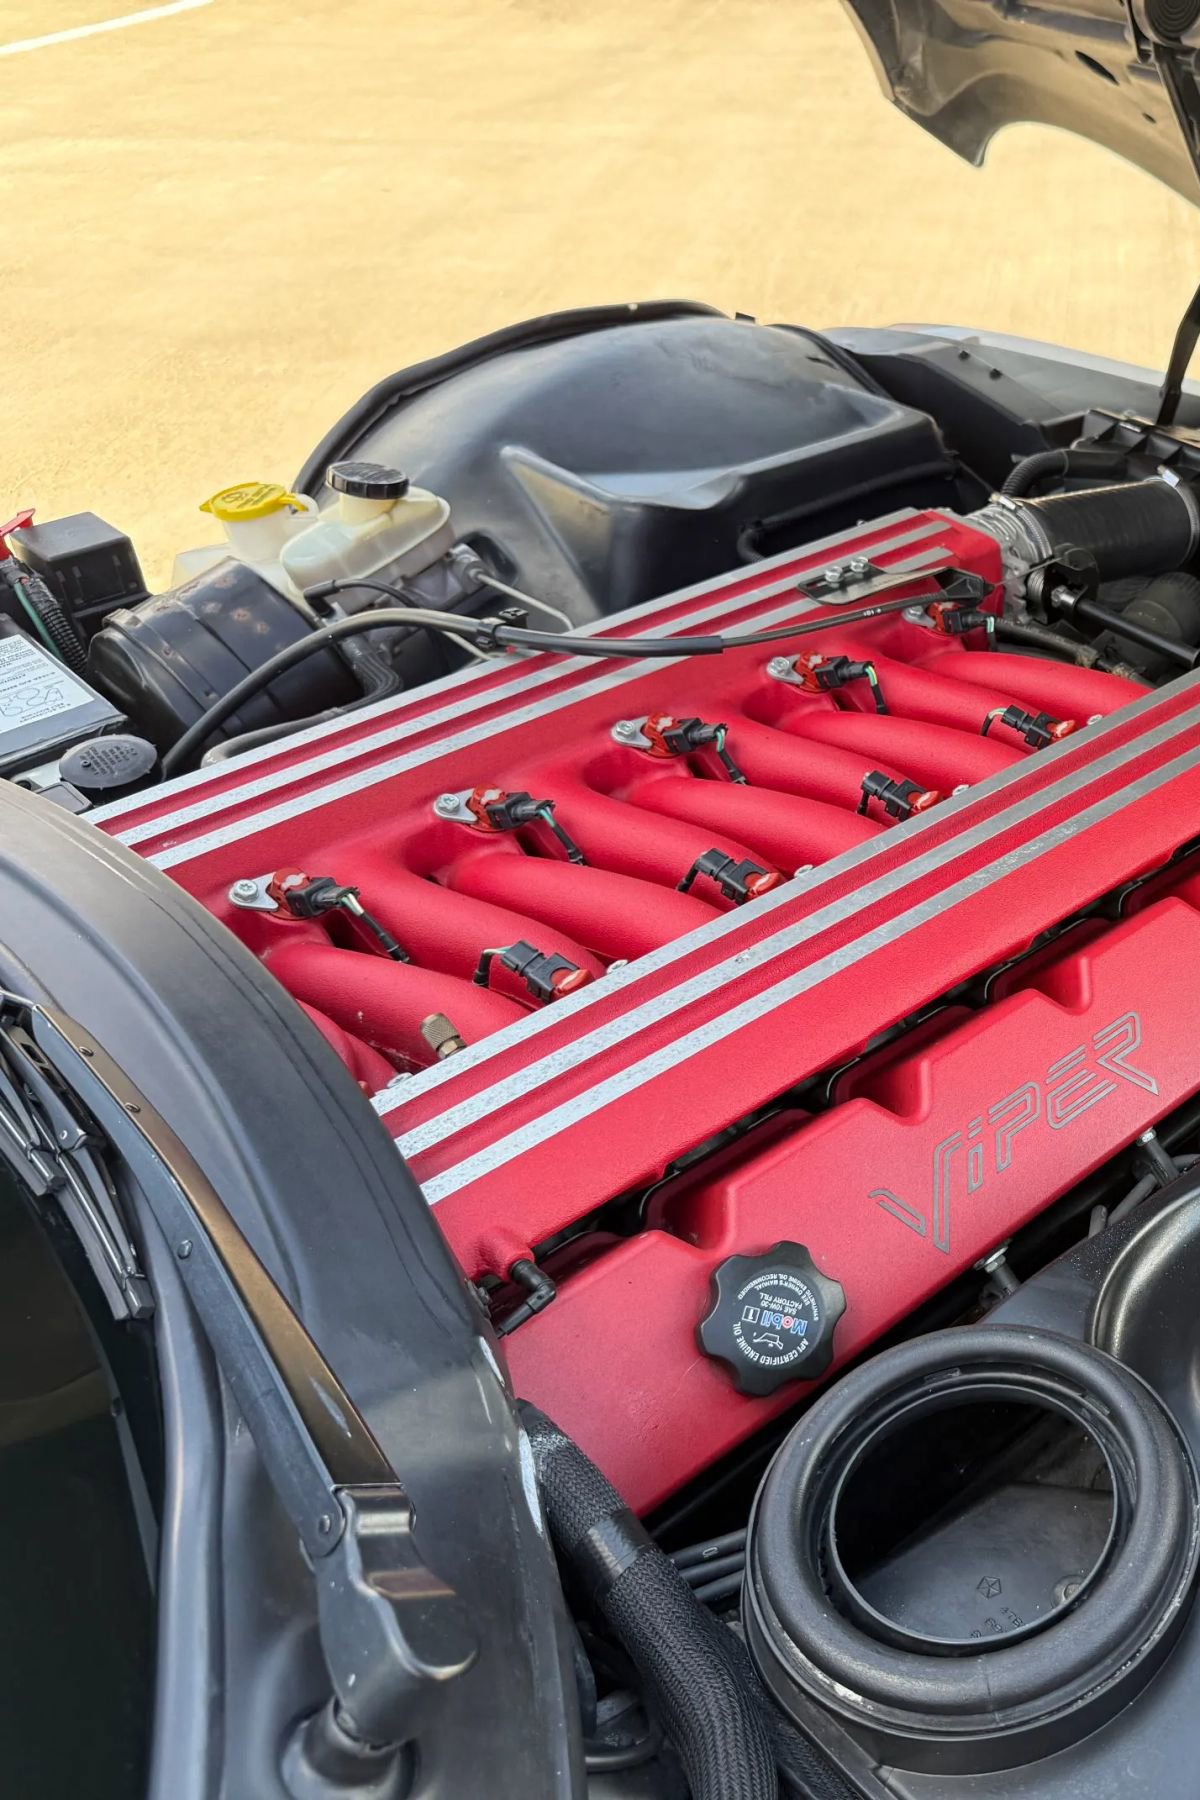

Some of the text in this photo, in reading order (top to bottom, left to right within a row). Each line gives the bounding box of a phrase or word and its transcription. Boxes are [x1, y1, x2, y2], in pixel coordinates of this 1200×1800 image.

[737, 1273, 778, 1300] RECOMMENDED
[753, 1279, 779, 1291] MANUAL
[787, 1275, 808, 1291] ENGINE
[759, 1292, 803, 1310] FACTORY FILL
[760, 1299, 798, 1316] SAE 10W-30
[800, 1293, 811, 1306] SEE
[805, 1289, 819, 1321] SYNTHETIC
[760, 1309, 808, 1337] Mobil
[732, 1321, 810, 1366] API CERTIFIED ENGINE OIL
